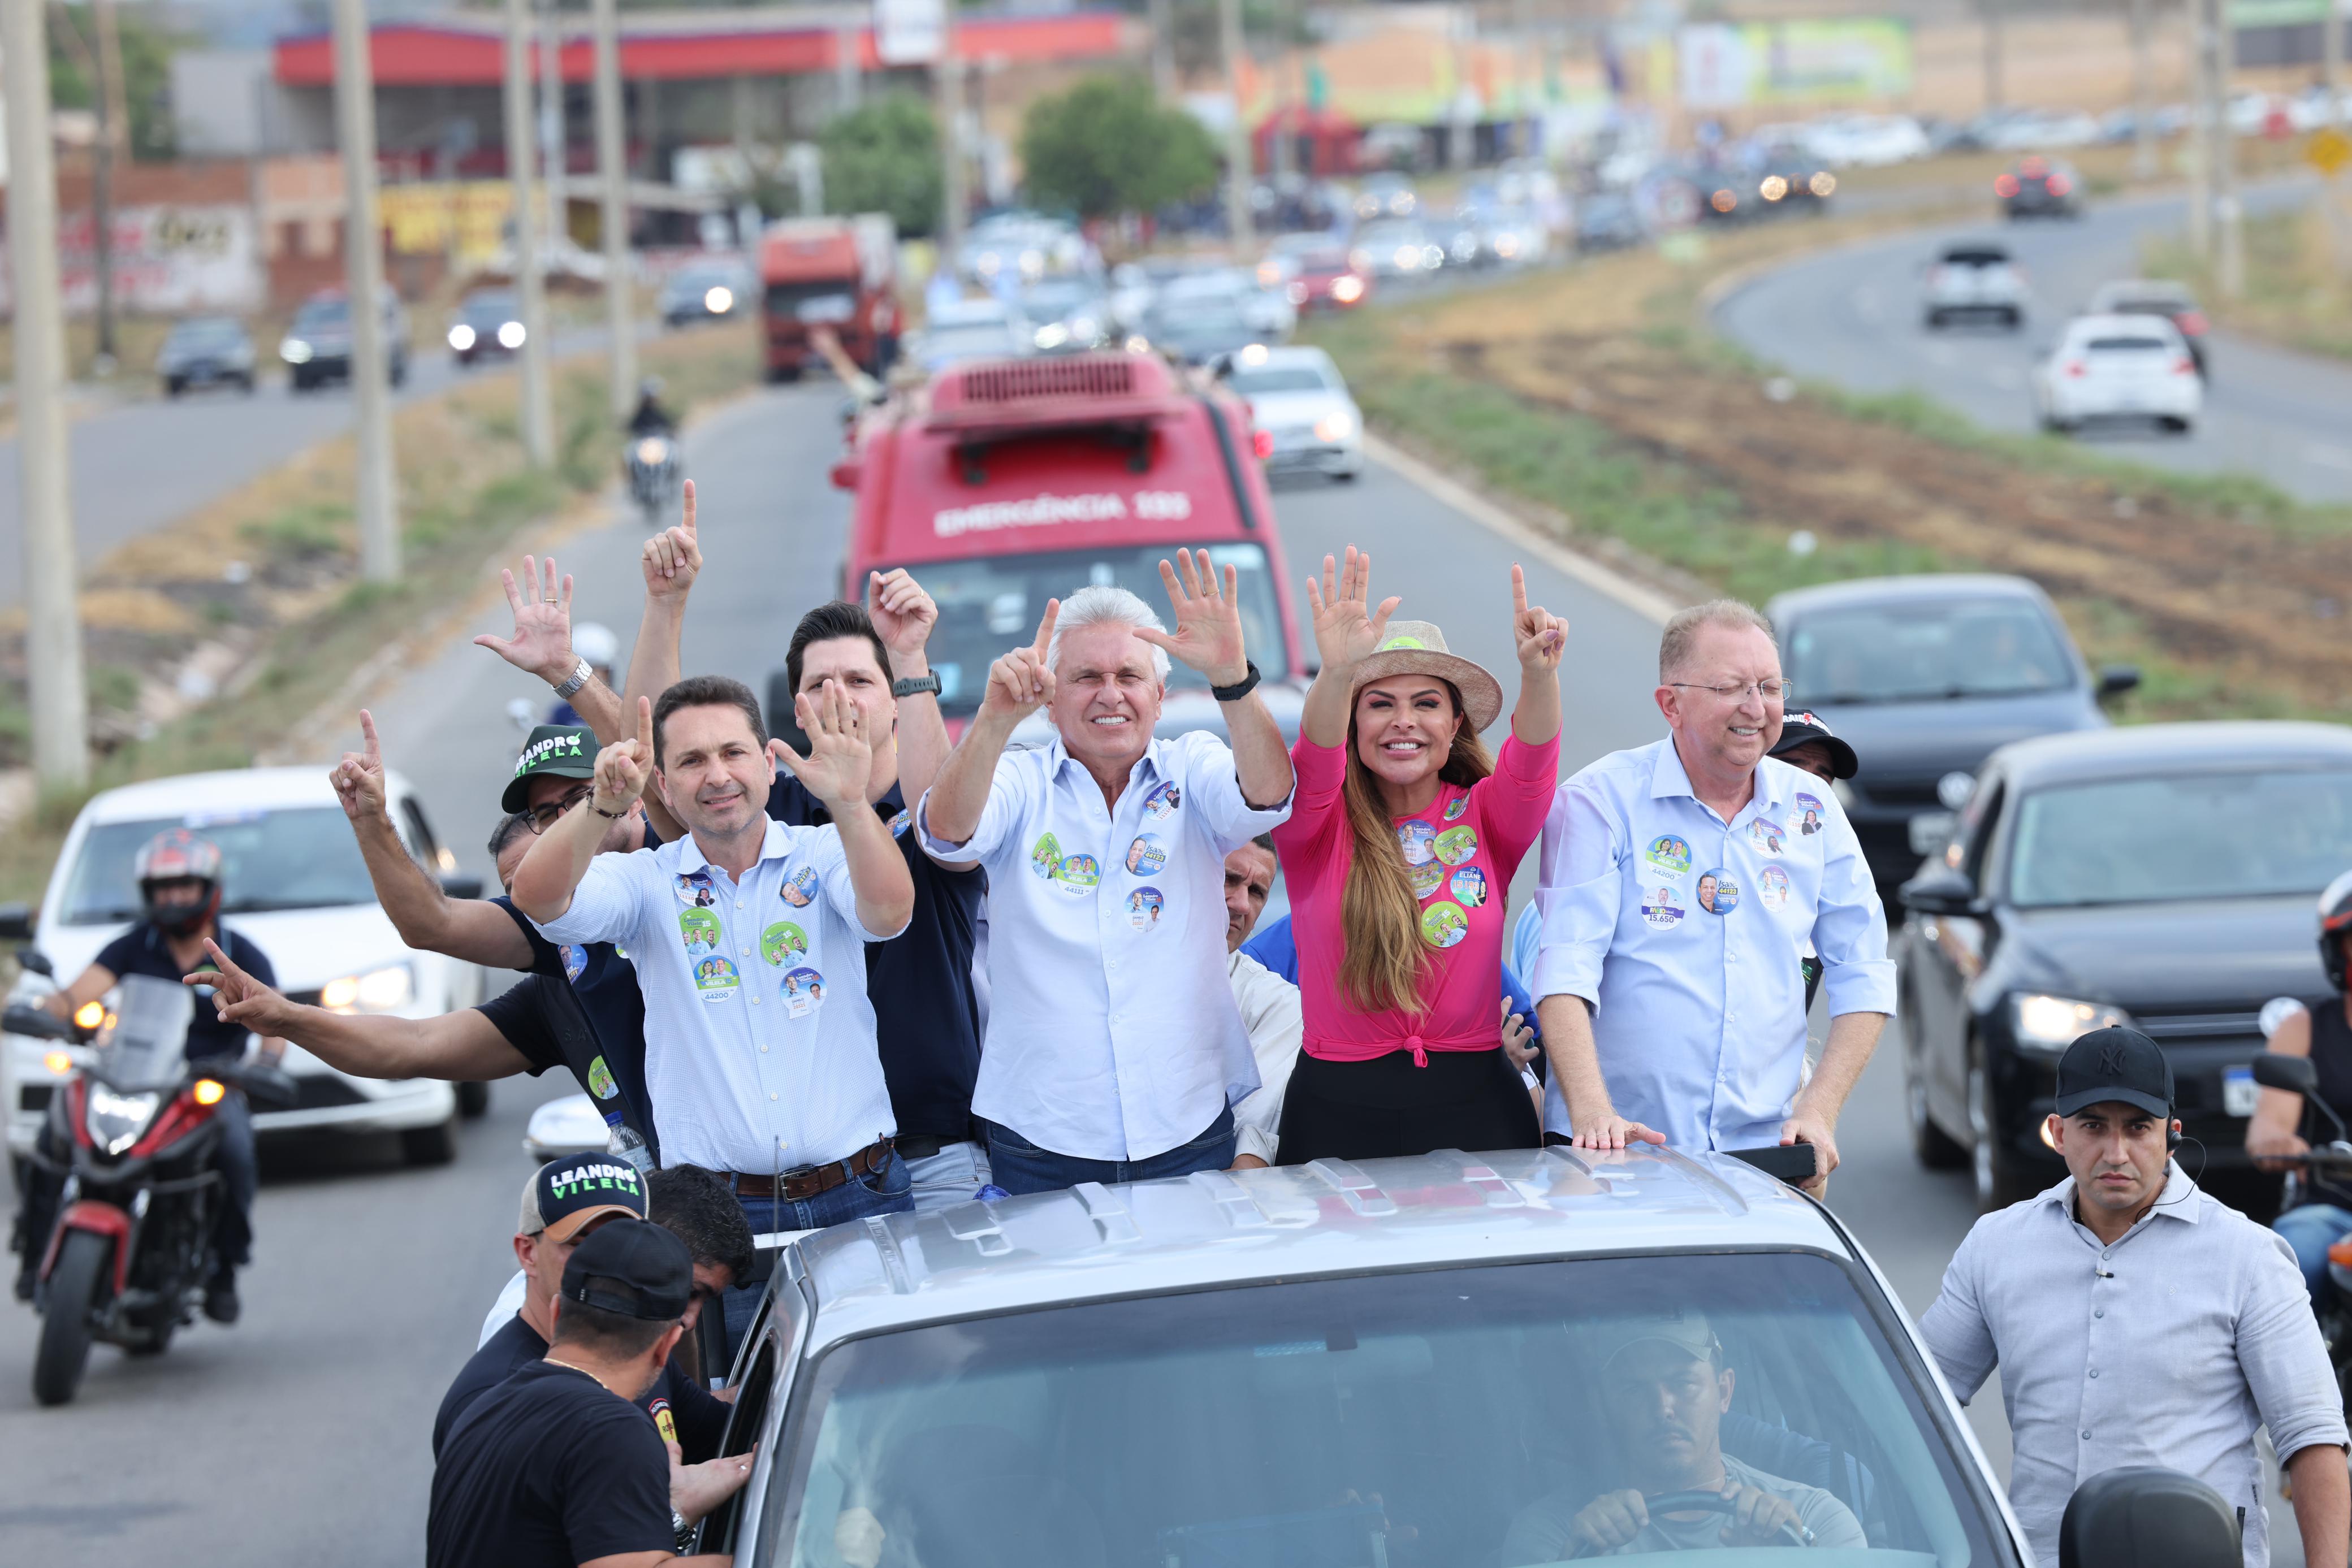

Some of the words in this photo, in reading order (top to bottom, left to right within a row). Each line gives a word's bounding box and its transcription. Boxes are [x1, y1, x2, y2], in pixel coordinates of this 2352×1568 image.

[1145, 852, 1165, 862] 44123
[1652, 868, 1675, 880] 44200
[1065, 886, 1083, 895] 44111
[1416, 889, 1434, 898] 7500
[1442, 909, 1451, 919] 15
[1649, 914, 1674, 923] 15.650
[783, 930, 792, 939] 15
[551, 1164, 637, 1188] LEANDRO
[552, 1177, 640, 1199] VILELA
